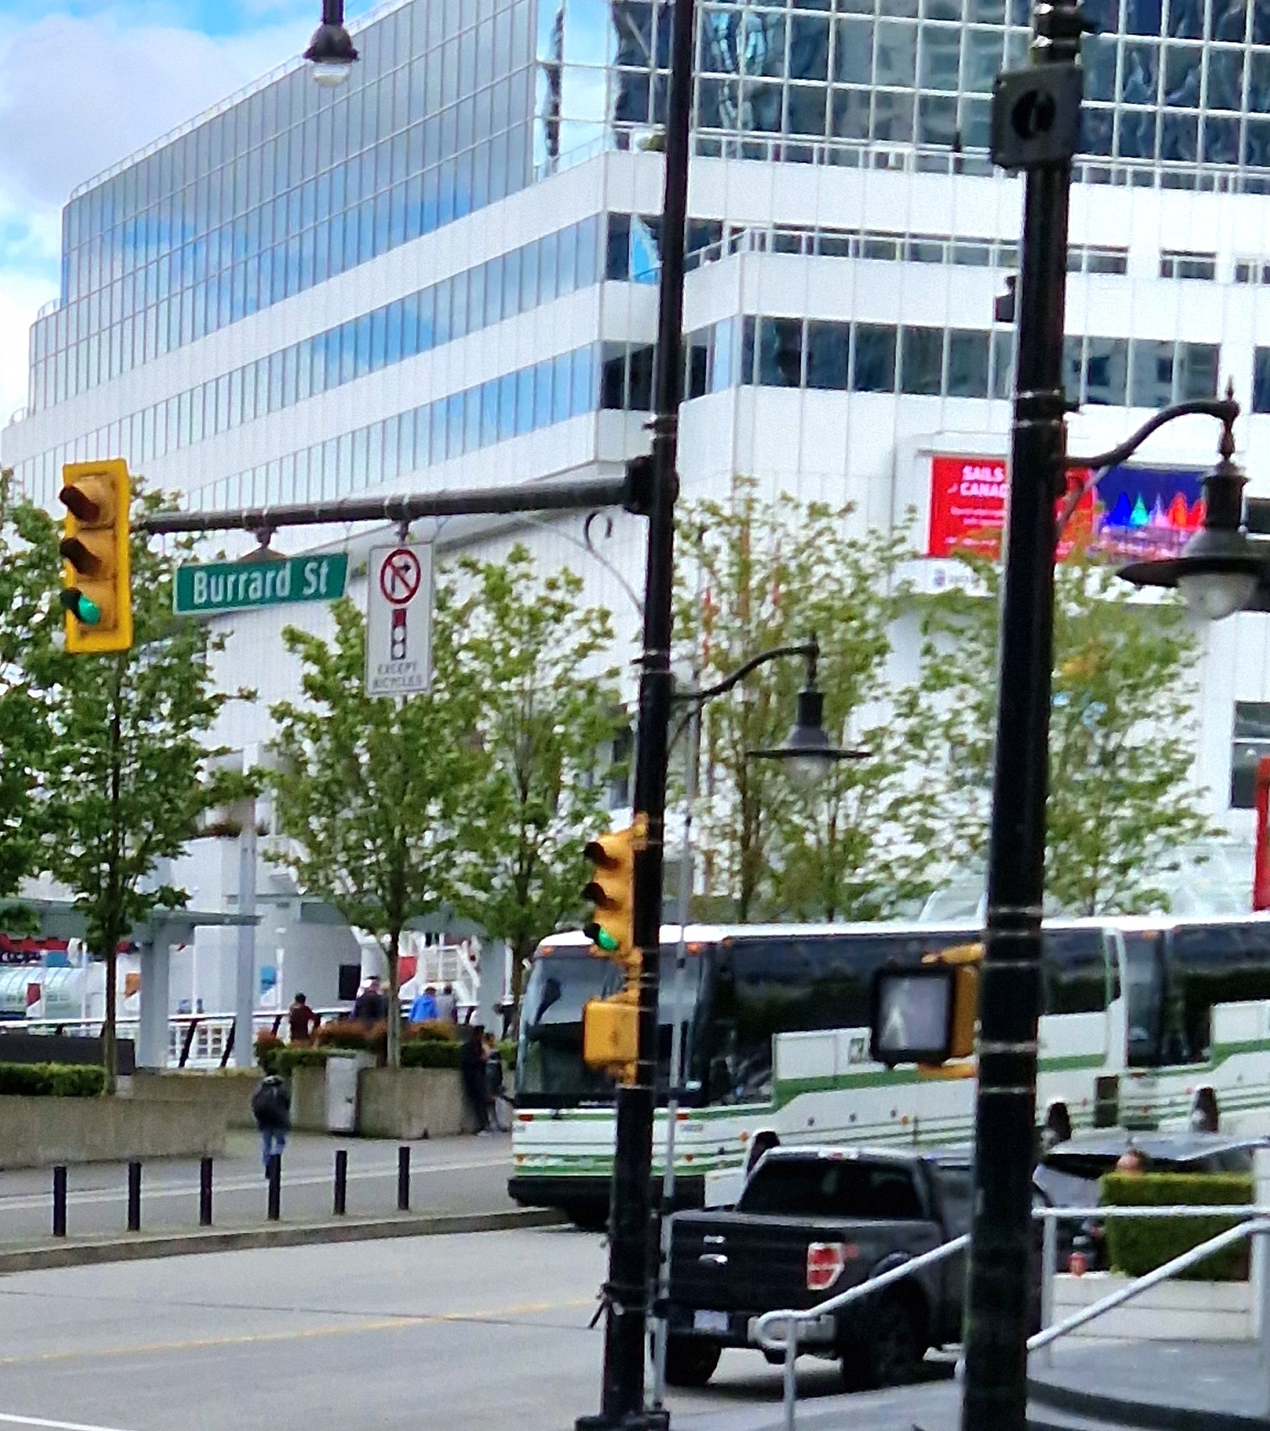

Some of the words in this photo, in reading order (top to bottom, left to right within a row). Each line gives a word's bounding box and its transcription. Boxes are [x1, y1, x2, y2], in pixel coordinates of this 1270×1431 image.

[962, 466, 1005, 482] SAILS
[193, 561, 292, 604] Burrard
[302, 559, 330, 596] St
[377, 661, 417, 674] EXCEPT
[373, 675, 422, 688] BICYCLES
